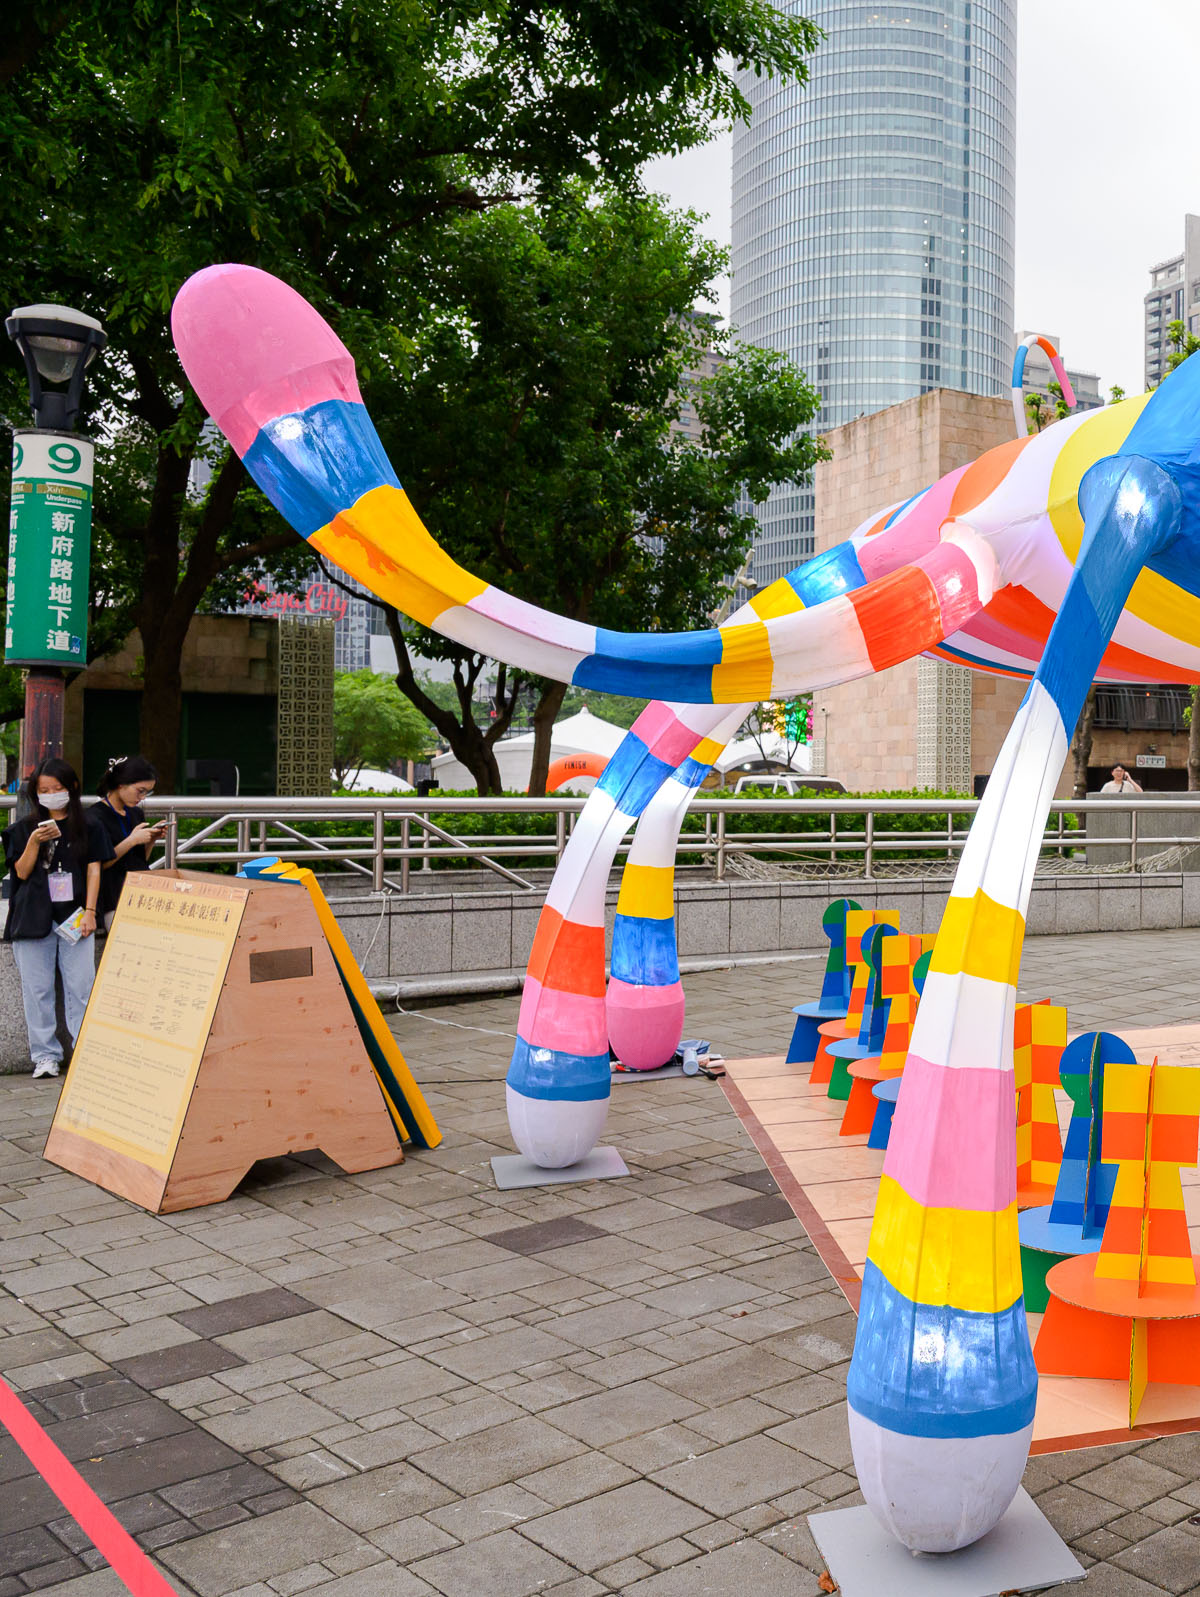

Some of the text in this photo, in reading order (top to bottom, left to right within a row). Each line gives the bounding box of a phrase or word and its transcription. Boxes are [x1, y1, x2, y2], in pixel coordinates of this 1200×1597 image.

[48, 443, 81, 473] 9
[46, 494, 82, 505] Underpass
[46, 511, 75, 651] 新府路地下道
[305, 583, 348, 622] City
[564, 760, 587, 769] FINISH
